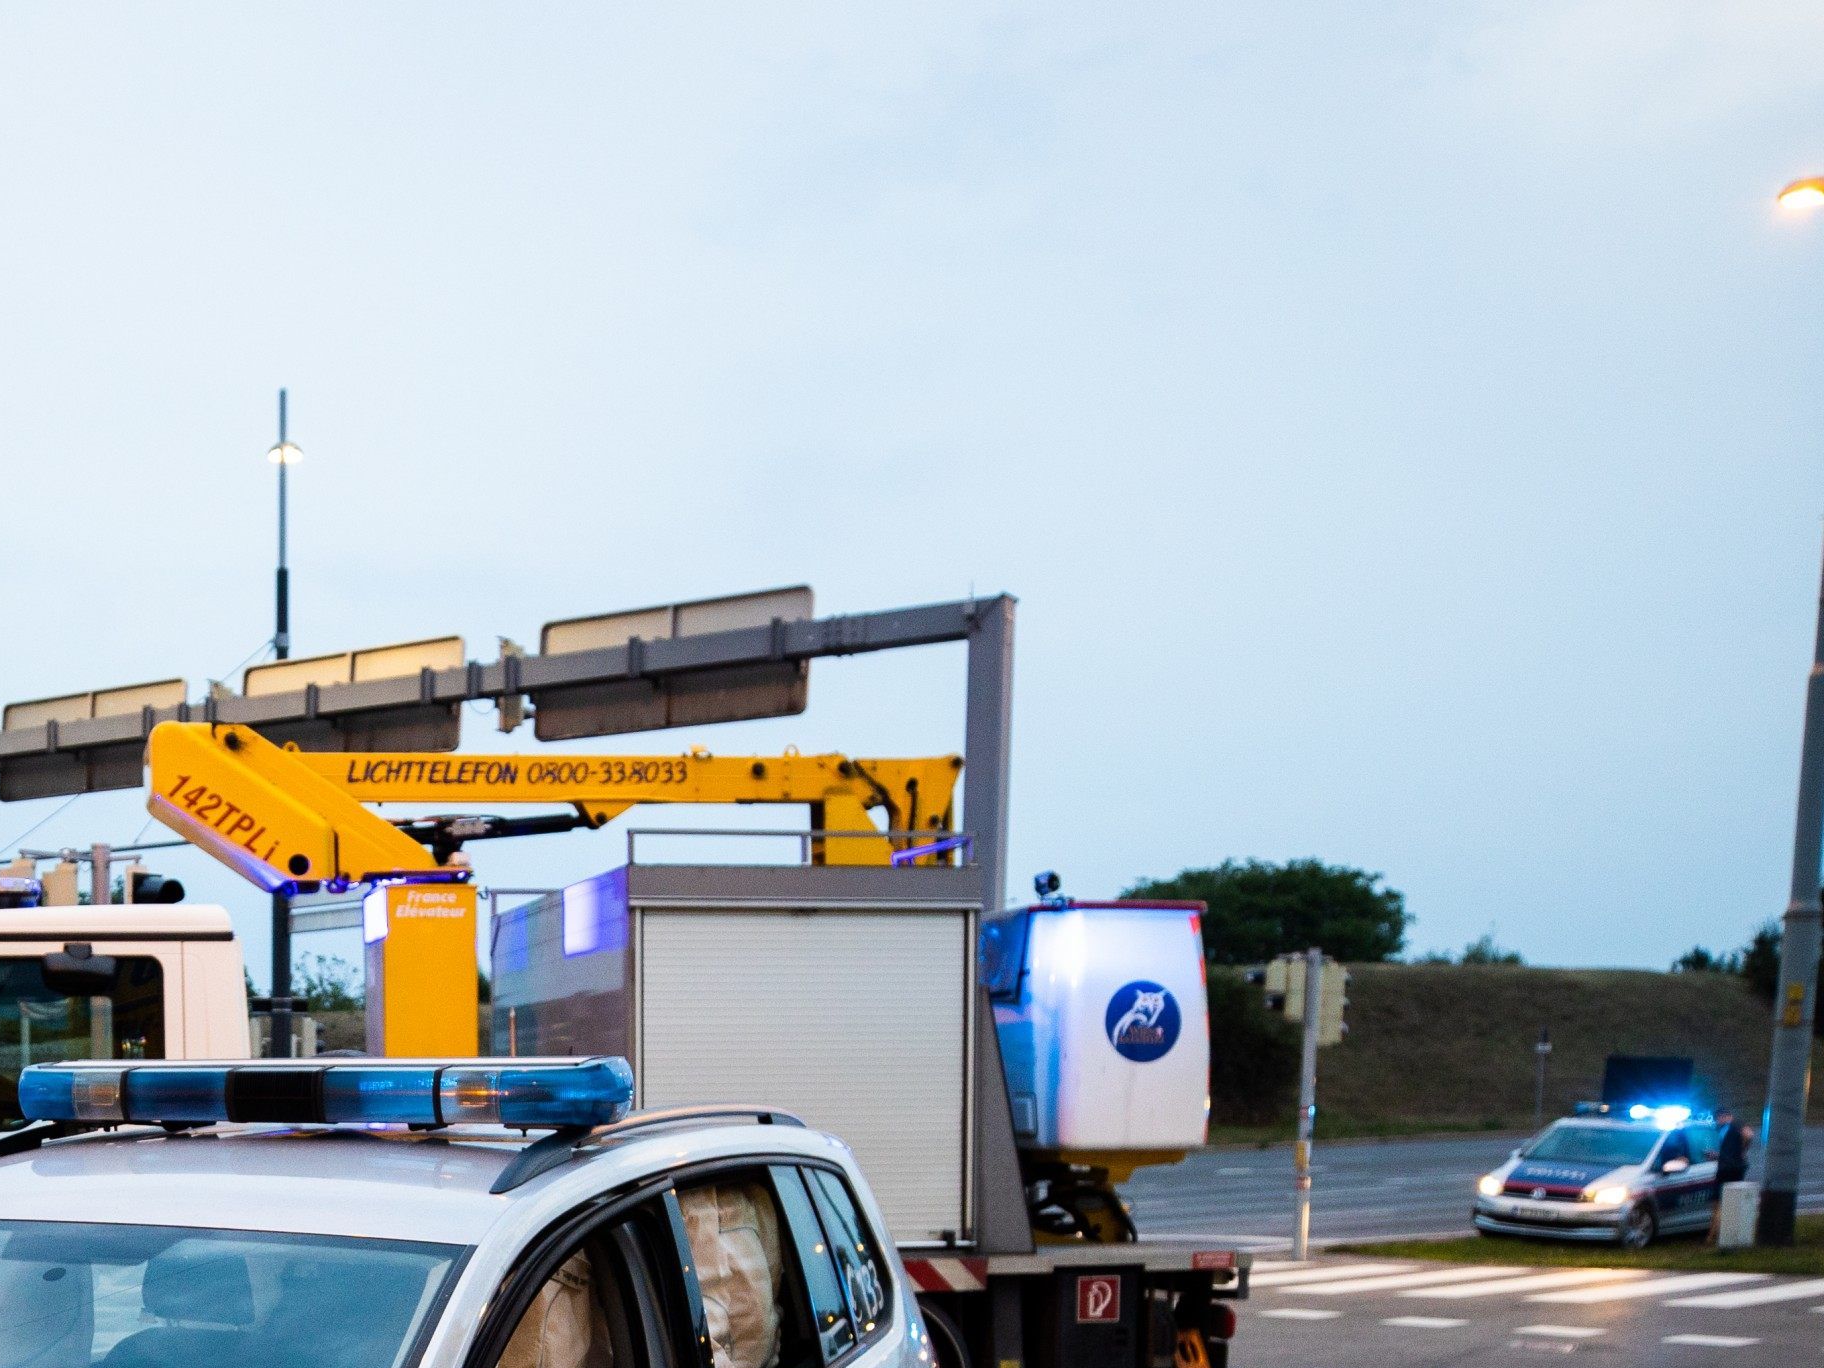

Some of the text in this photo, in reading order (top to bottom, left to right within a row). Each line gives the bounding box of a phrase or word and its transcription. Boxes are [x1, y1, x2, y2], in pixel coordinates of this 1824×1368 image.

[346, 759, 689, 785] LICHTTELEFON 0800-338033
[407, 890, 457, 903] France
